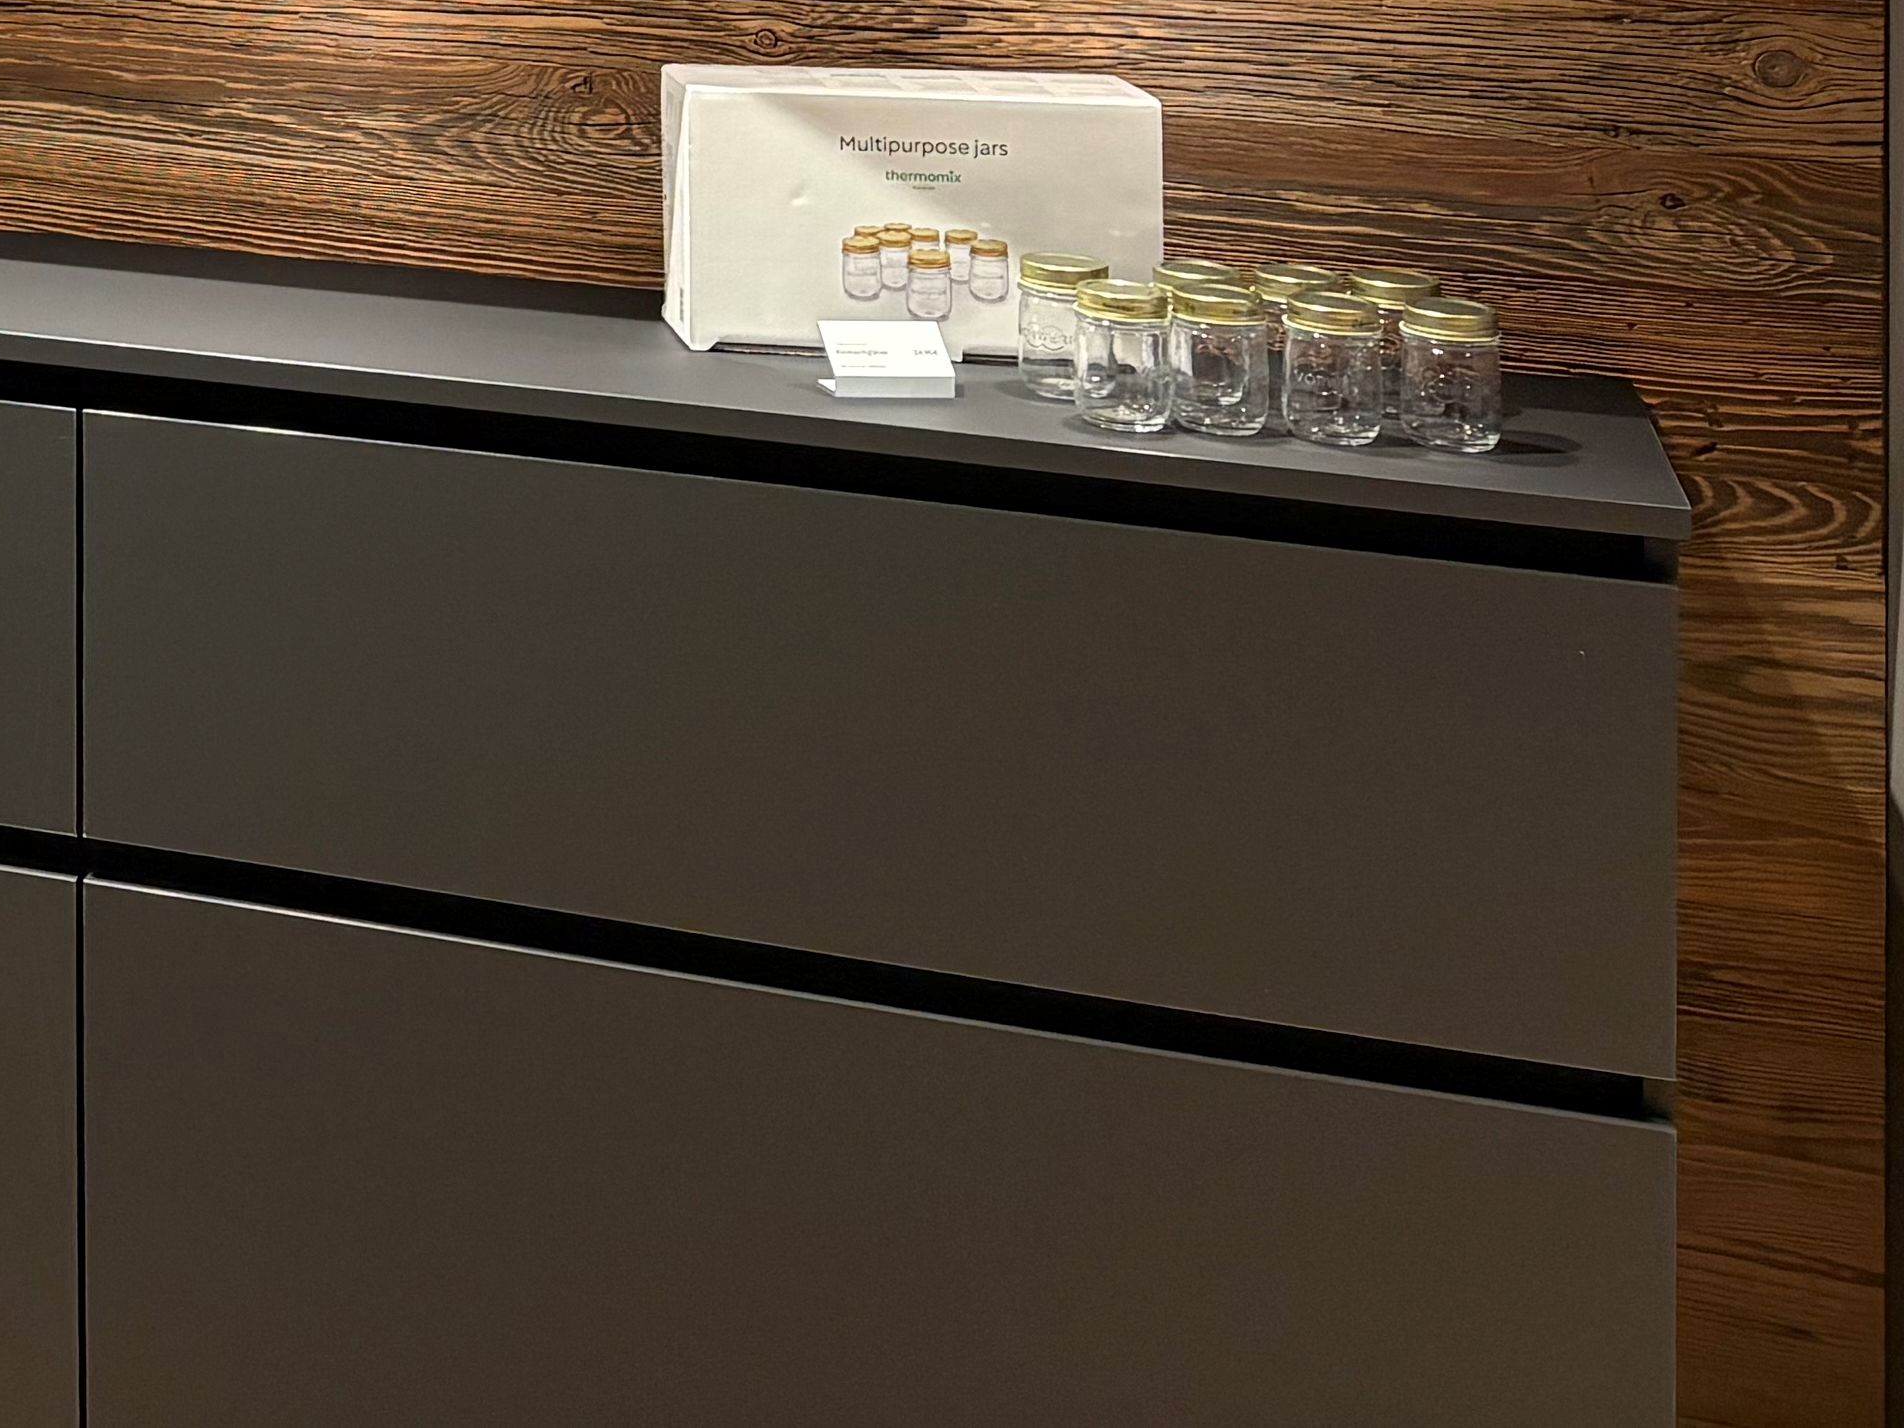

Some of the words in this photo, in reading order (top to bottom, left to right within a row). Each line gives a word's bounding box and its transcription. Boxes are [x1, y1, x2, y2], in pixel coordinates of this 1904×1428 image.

[840, 135, 970, 158] Multipurpose
[972, 138, 1009, 160] jars
[885, 170, 962, 184] thermomix
